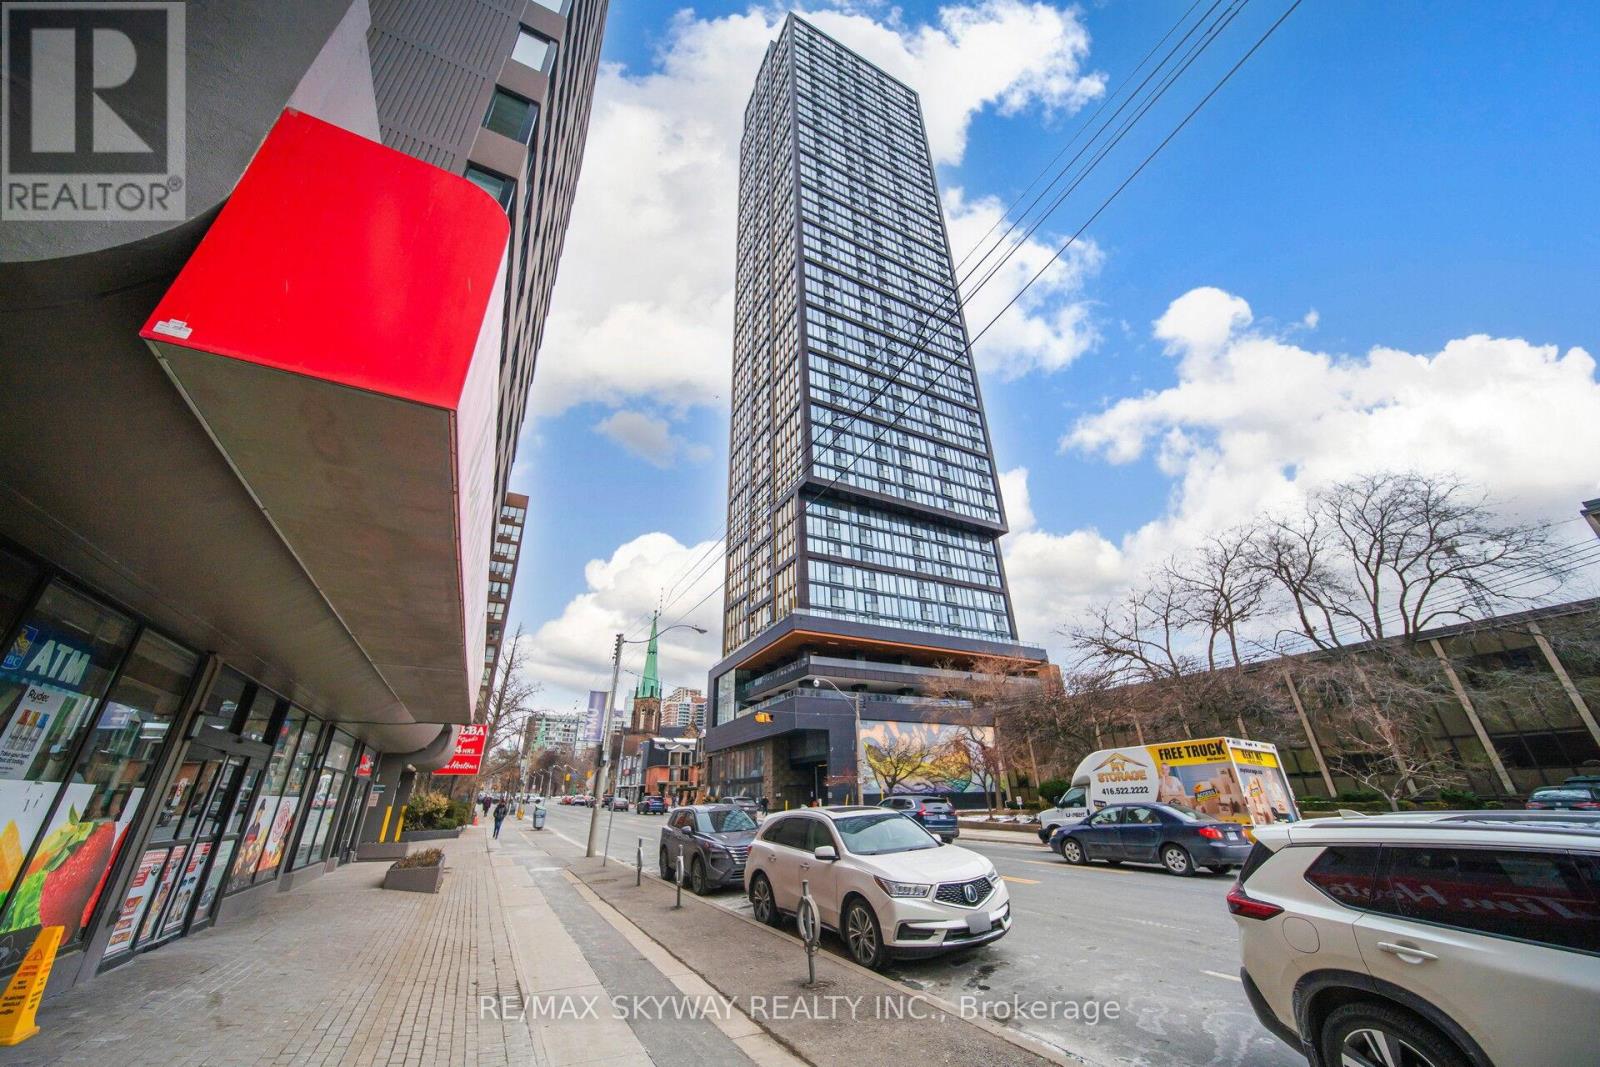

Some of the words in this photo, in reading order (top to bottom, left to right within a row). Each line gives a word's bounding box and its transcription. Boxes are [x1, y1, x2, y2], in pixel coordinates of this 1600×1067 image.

[26, 640, 91, 686] ATM
[1158, 746, 1183, 761] FREE
[1185, 742, 1226, 758] TRUCK
[1097, 770, 1147, 783] STORAGE
[1102, 786, 1150, 795] 416.522.2222
